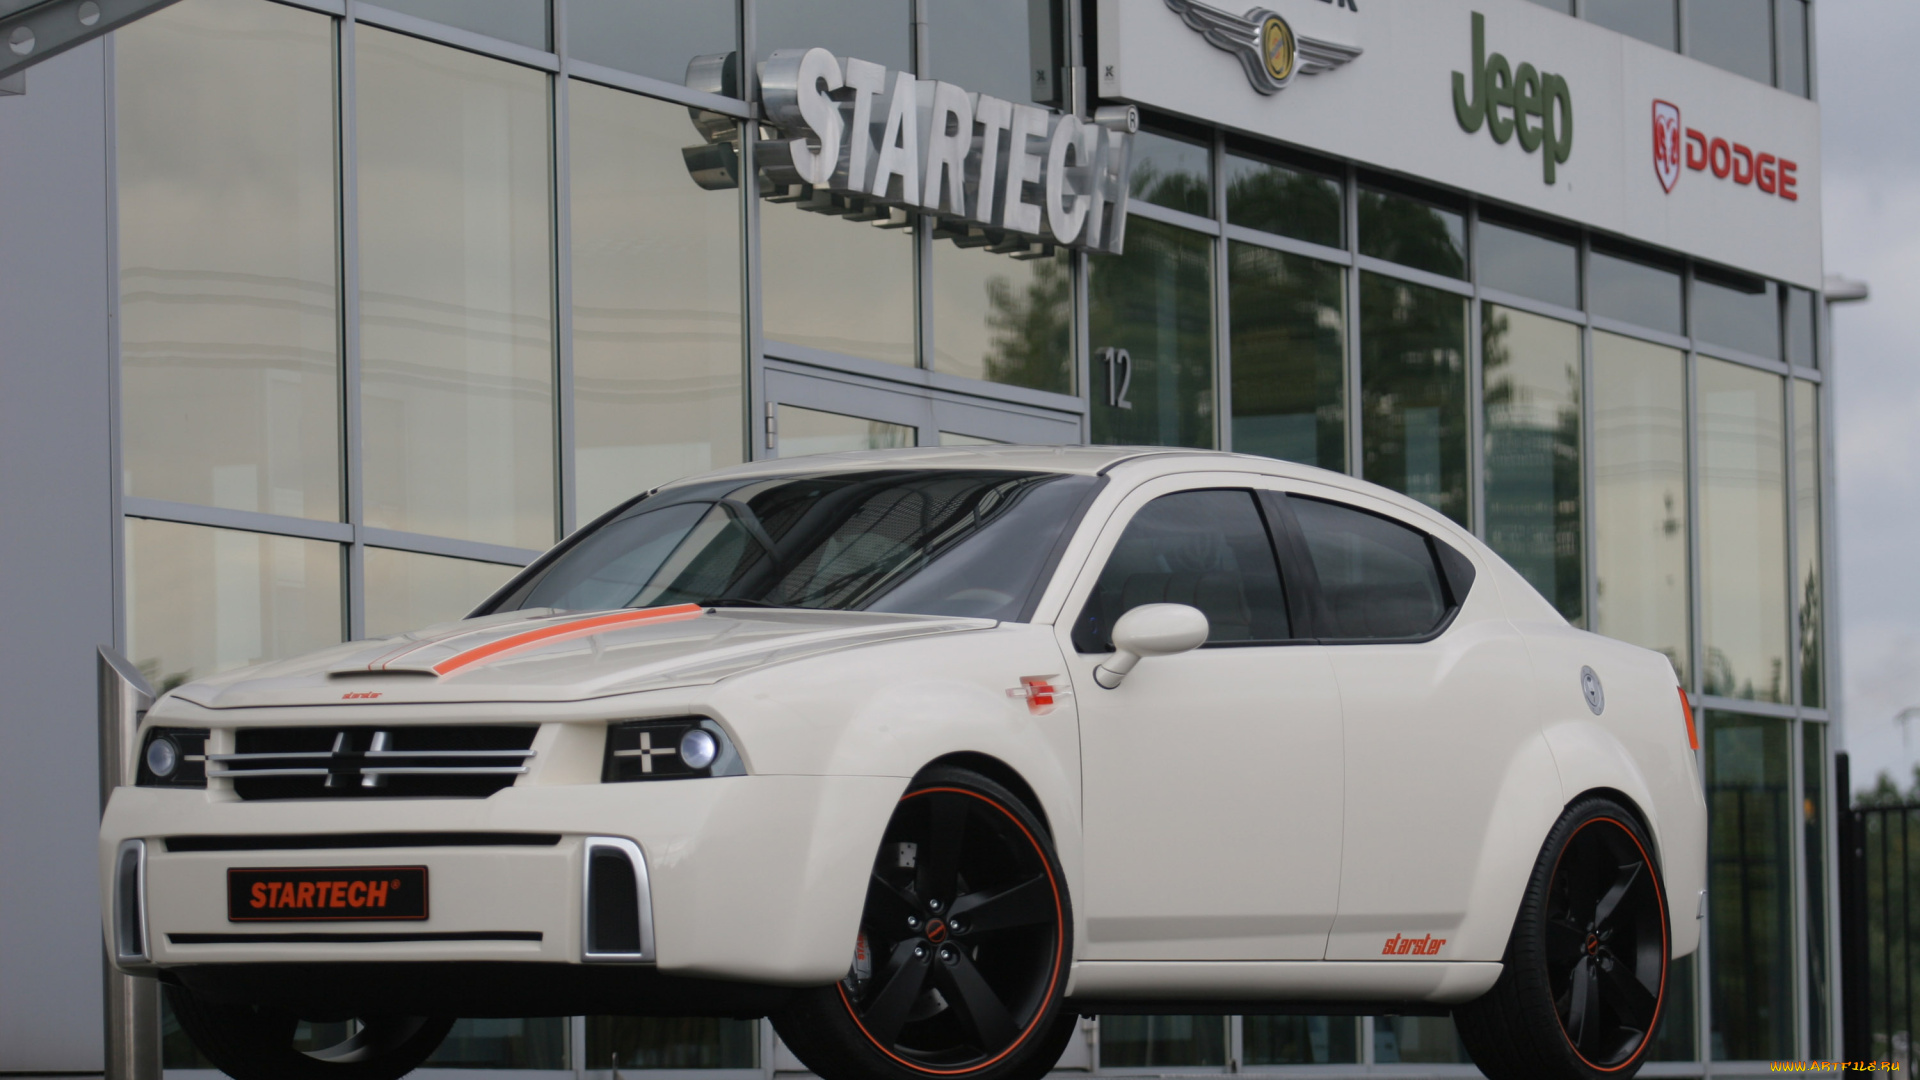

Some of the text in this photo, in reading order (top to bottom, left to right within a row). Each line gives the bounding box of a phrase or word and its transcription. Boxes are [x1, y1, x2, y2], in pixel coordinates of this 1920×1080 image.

[1451, 10, 1573, 186] Jeep
[1686, 127, 1797, 201] DODGE
[1104, 346, 1133, 410] 12
[1382, 932, 1447, 955] starster
